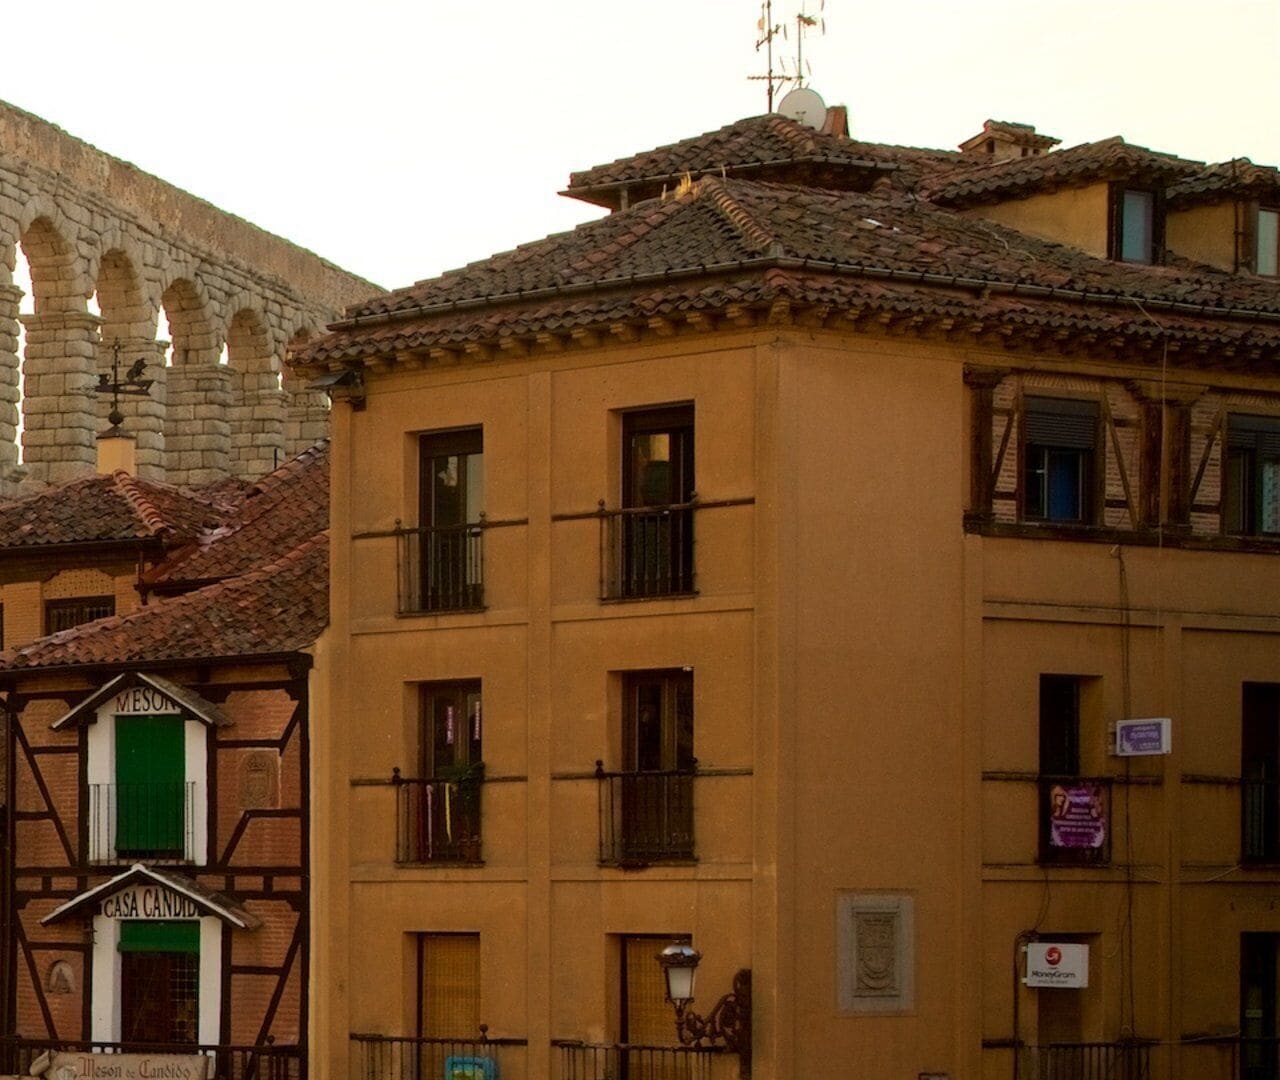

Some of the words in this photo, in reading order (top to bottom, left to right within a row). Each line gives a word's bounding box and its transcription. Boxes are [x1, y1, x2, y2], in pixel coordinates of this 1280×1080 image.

[115, 688, 178, 713] MESON
[103, 891, 139, 918] CASA
[143, 888, 199, 918] CANDID
[1031, 969, 1077, 979] MoneyGram
[125, 1069, 136, 1079] de
[139, 1059, 189, 1080] Candido
